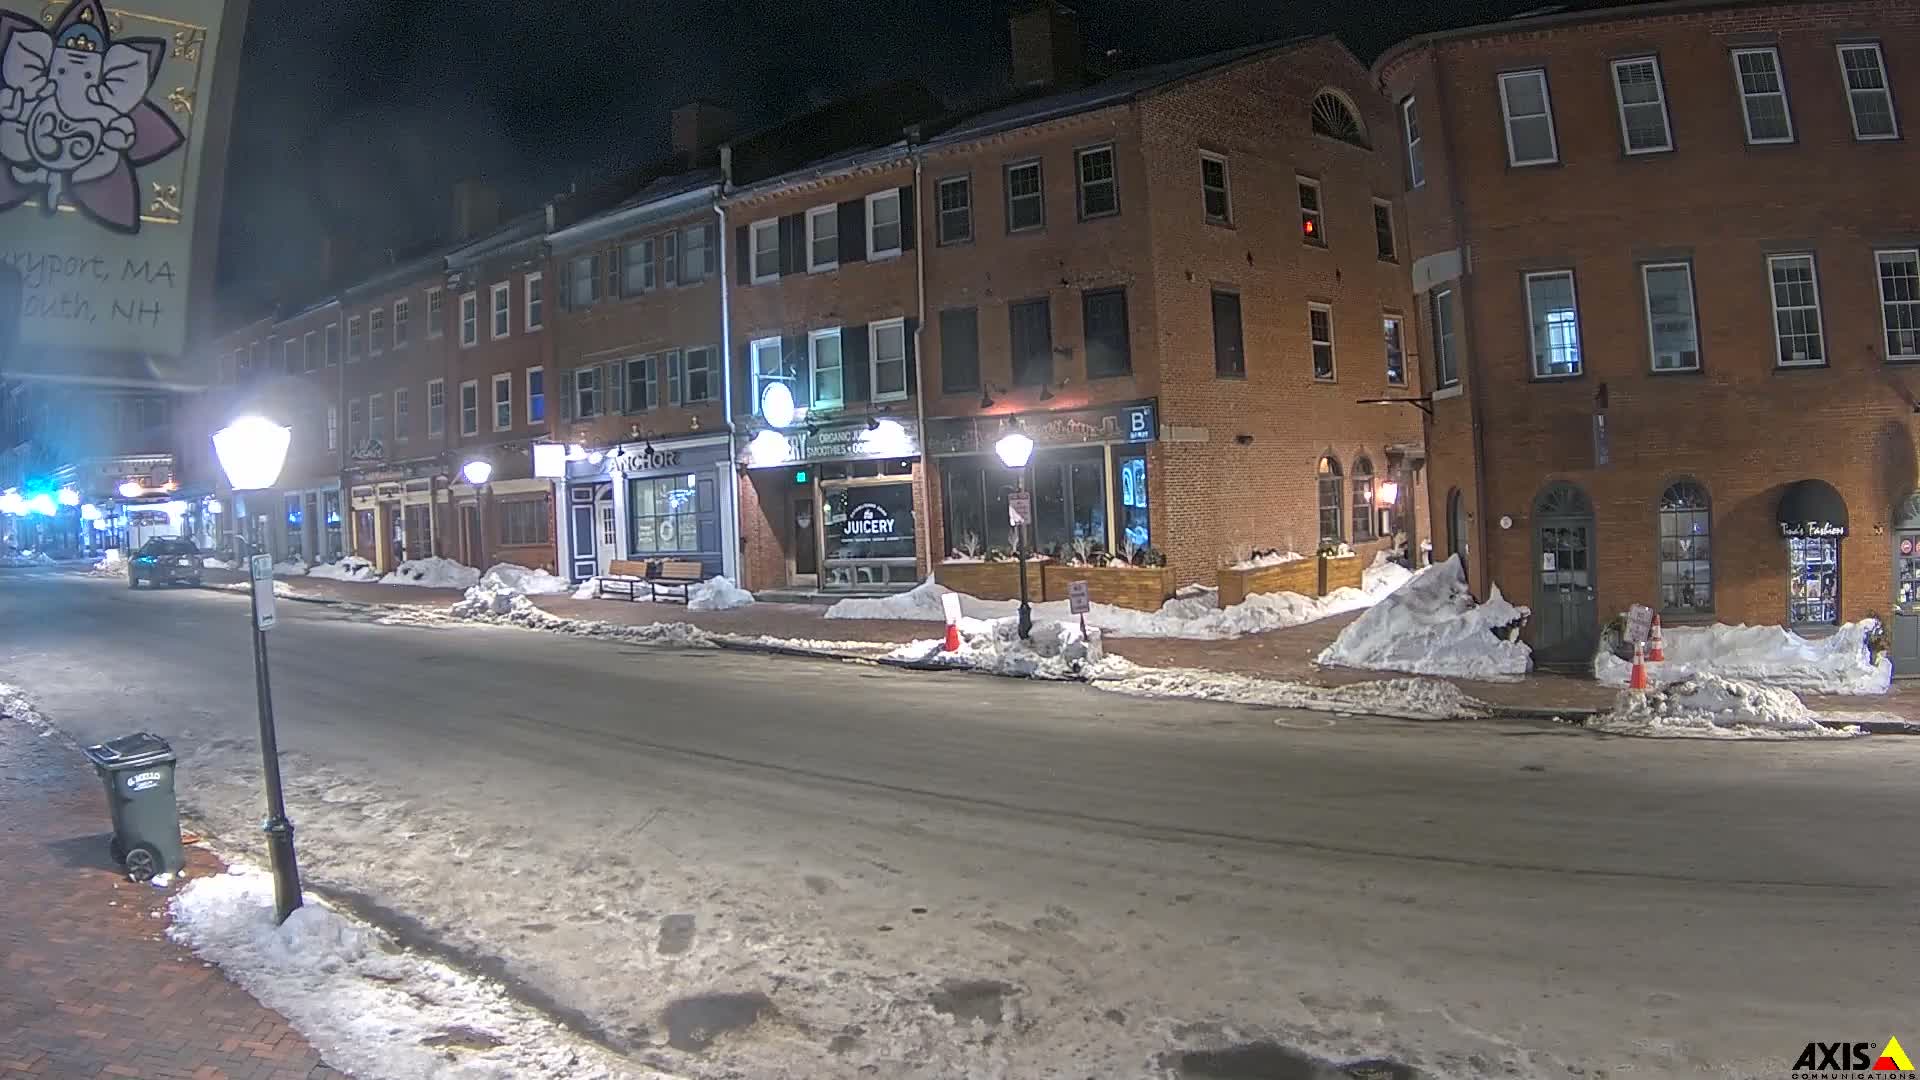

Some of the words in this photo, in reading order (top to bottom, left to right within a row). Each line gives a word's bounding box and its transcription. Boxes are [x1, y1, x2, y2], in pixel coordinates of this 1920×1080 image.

[120, 258, 176, 289] MA
[111, 299, 161, 328] NH
[819, 431, 852, 444] ORGANIC
[807, 445, 846, 458] SMOOTHIES
[843, 519, 895, 534] JUICERY
